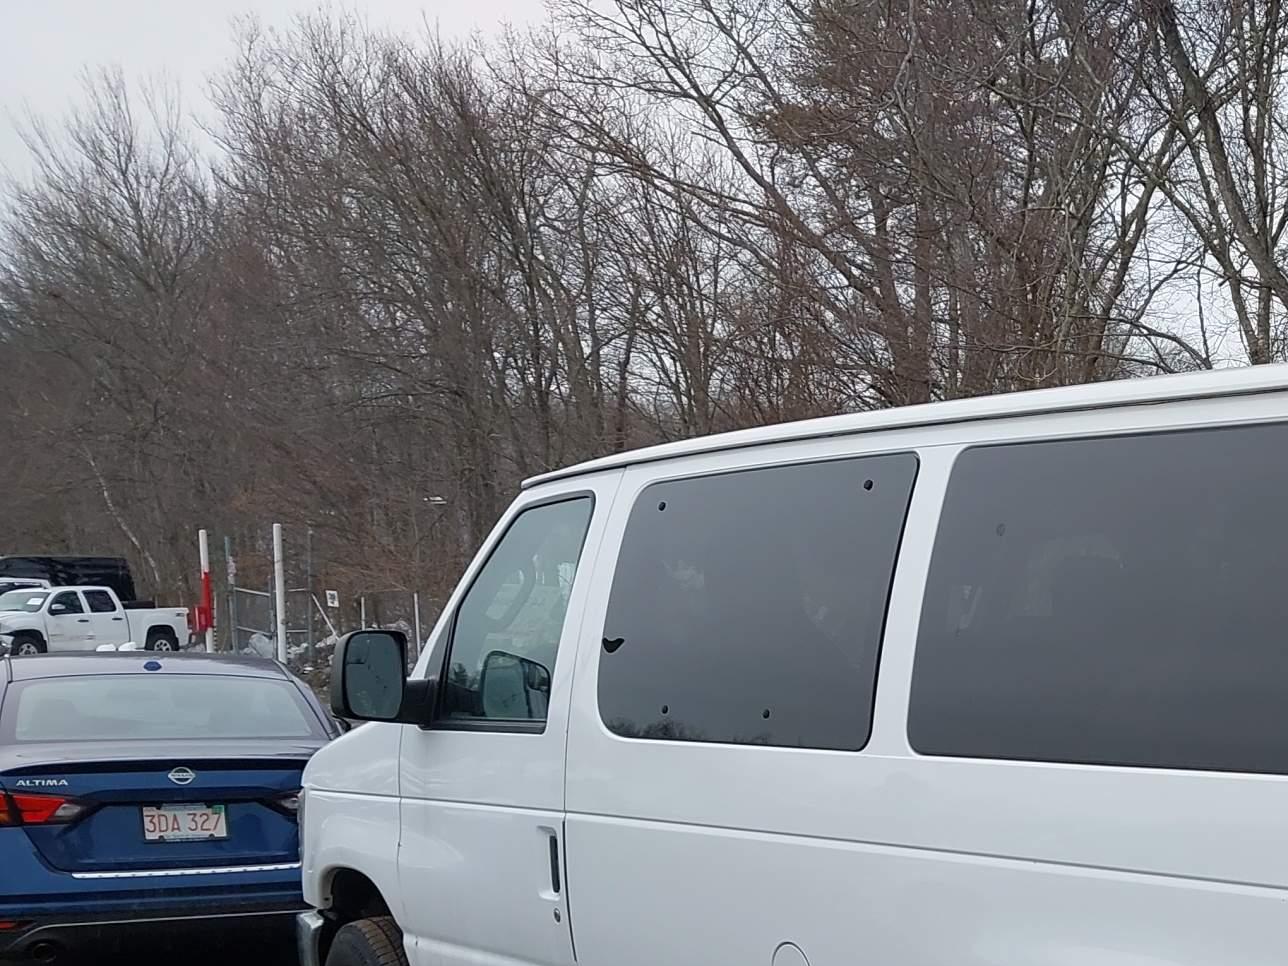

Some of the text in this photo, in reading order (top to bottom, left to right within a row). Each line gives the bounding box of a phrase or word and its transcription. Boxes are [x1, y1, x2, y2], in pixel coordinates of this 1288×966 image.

[15, 779, 69, 787] ALTIMA
[145, 812, 221, 833] 3DA 327
